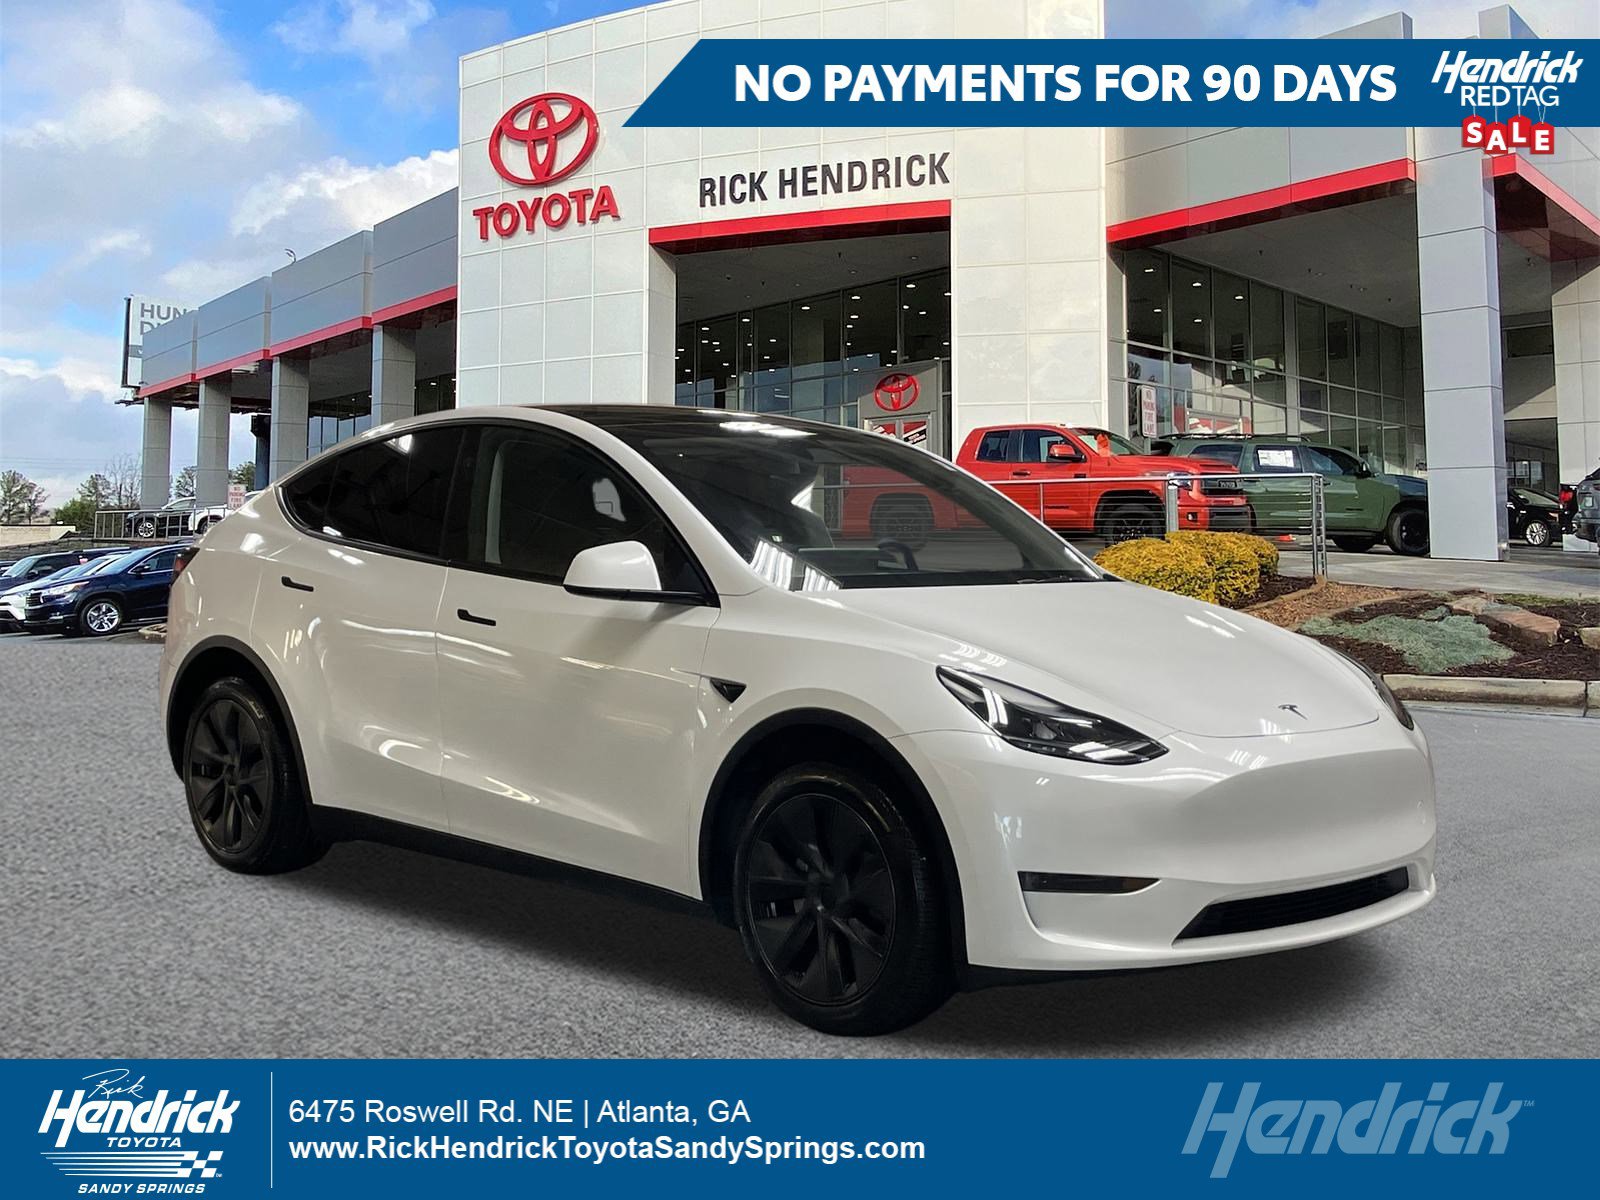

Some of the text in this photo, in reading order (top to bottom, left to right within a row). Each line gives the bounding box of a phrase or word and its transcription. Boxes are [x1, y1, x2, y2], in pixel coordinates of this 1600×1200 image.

[699, 151, 950, 208] RICK HENDRICK
[473, 185, 621, 241] TOYOTA
